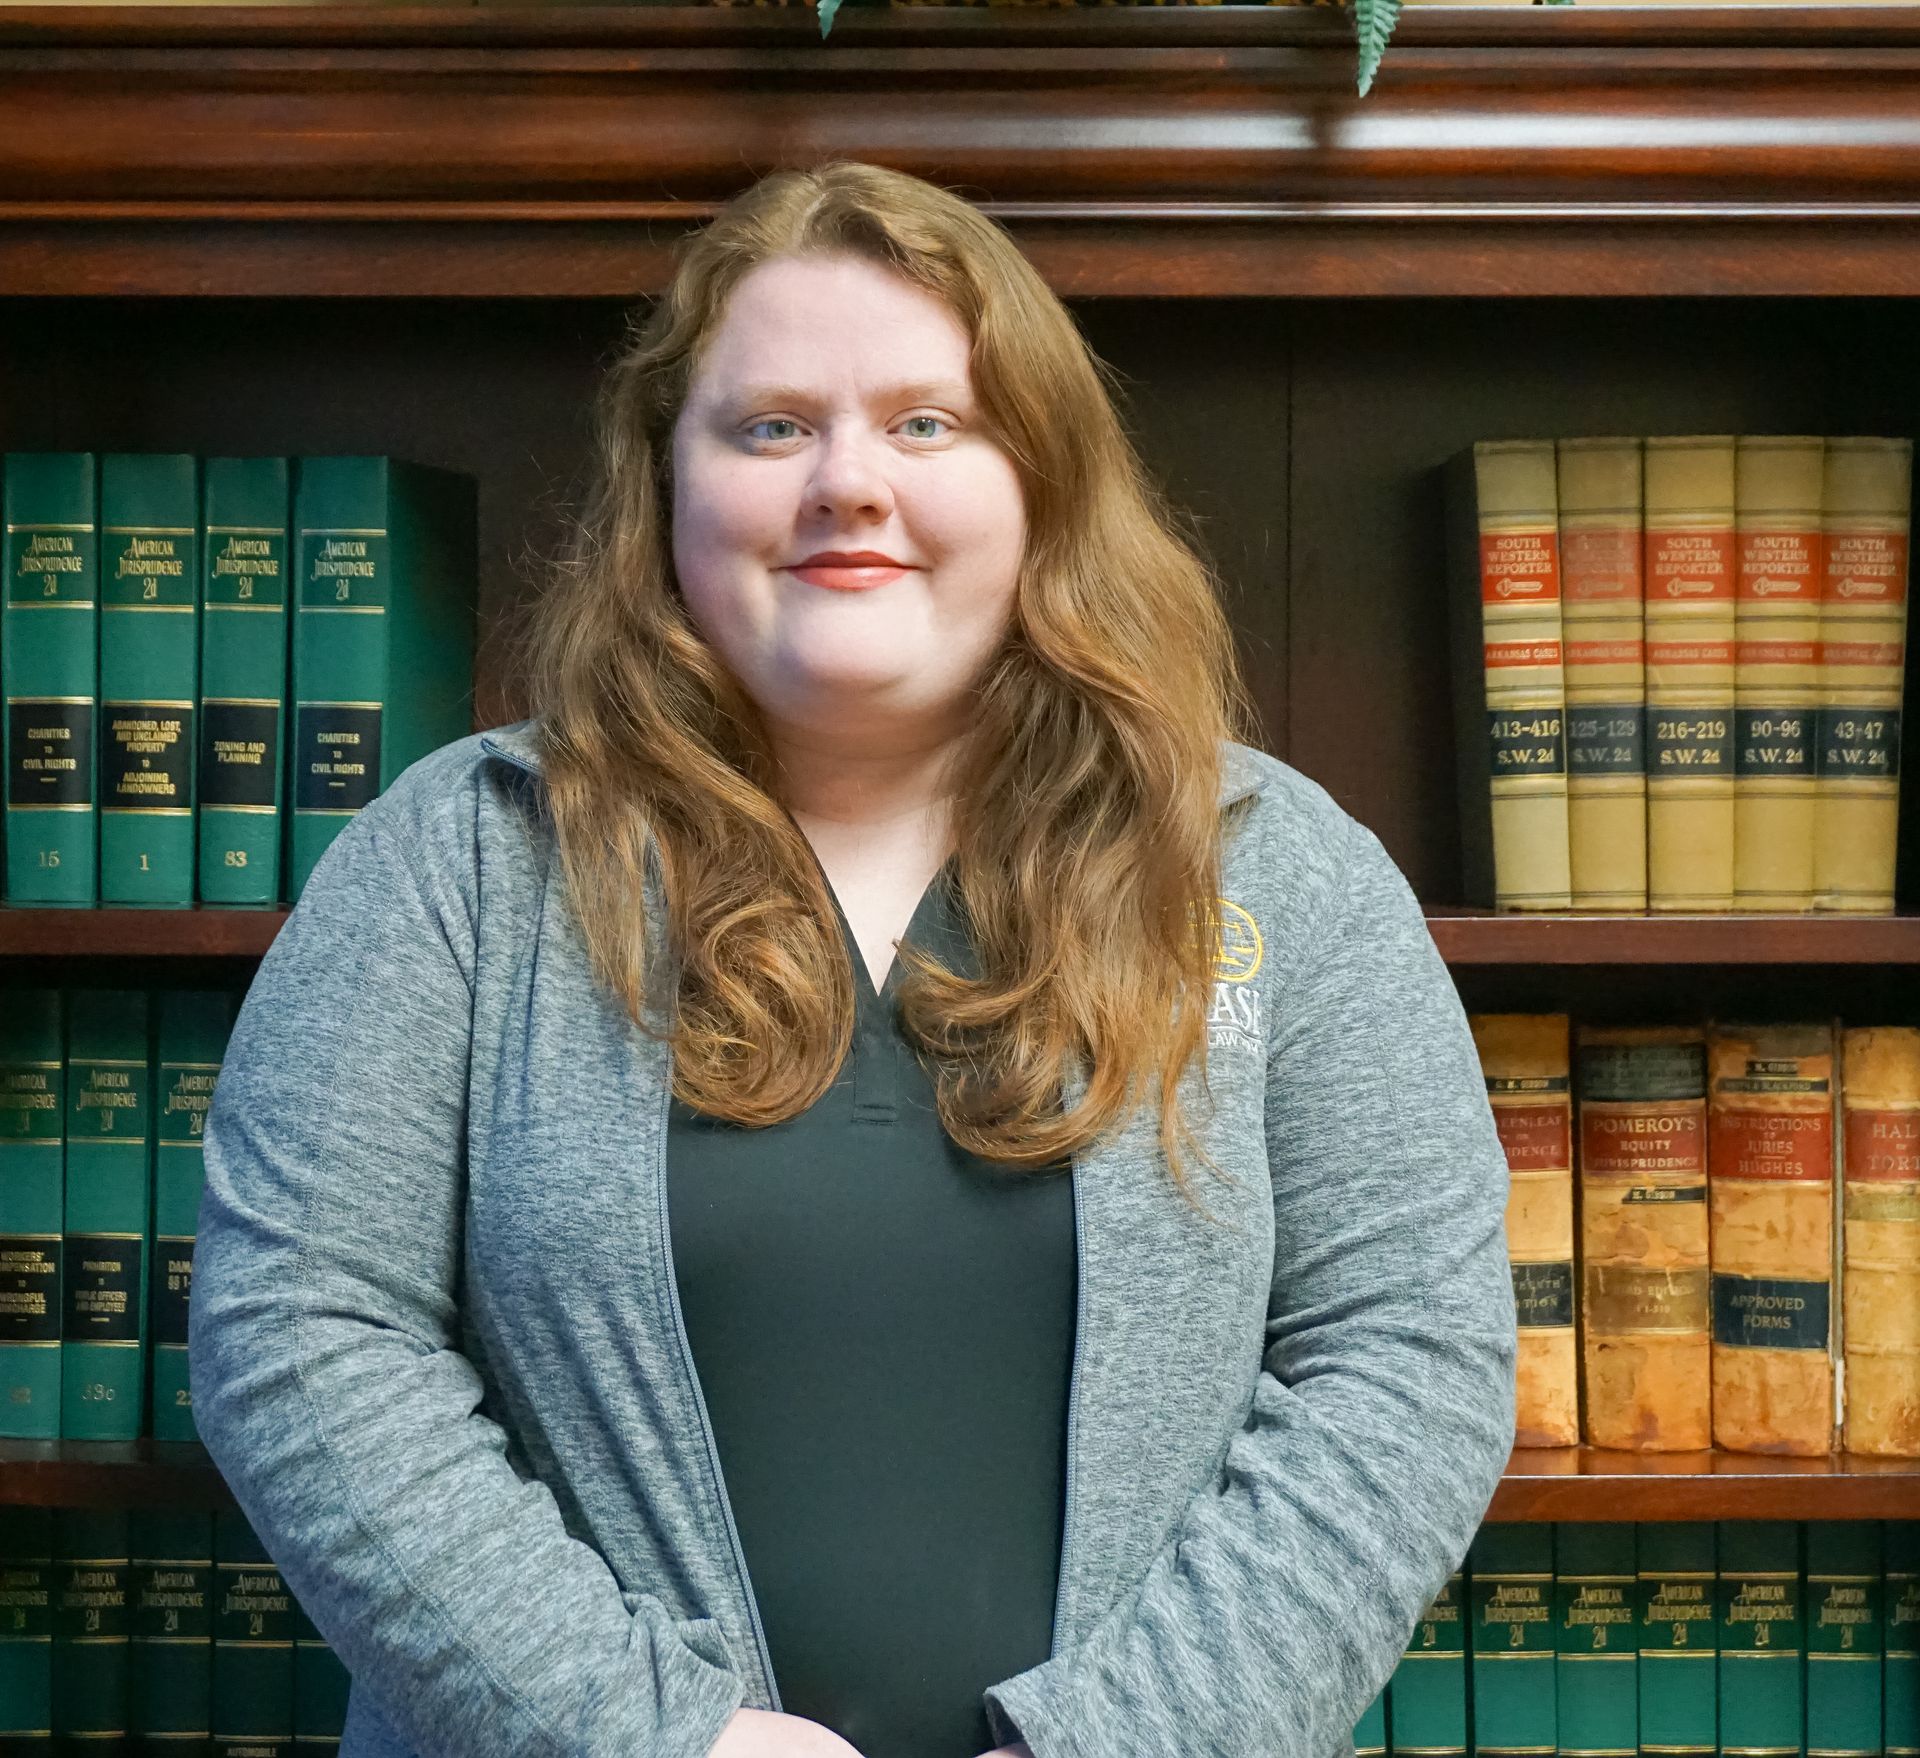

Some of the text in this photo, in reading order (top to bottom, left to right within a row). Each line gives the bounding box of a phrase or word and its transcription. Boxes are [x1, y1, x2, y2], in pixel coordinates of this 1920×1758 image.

[26, 534, 73, 554] AMERICAN
[124, 536, 174, 558] AMERICAN
[221, 536, 270, 558] AMERICAN
[319, 539, 368, 560] AMERICAN
[1496, 538, 1540, 550] SOUTH
[1666, 538, 1712, 549] SOUTH
[1754, 537, 1799, 548] SOUTH
[1839, 539, 1886, 550] SOUTH
[1487, 550, 1549, 561] WESTERN
[1658, 550, 1721, 561] WESTERN
[1744, 550, 1808, 561] WESTERN
[1831, 551, 1894, 562] WESTERN
[114, 557, 183, 579] JURISPRUDENCE
[212, 556, 279, 579] JURISPRUDENCE
[310, 558, 375, 581] JURISPRUDENCE
[1486, 562, 1552, 574] REPORTER
[1655, 562, 1724, 575] REPORTER
[1743, 562, 1809, 574] REPORTER
[1828, 563, 1896, 576] REPORTER
[143, 577, 157, 599] 2d
[112, 720, 182, 732] ABANDONED, LOST,
[1490, 720, 1560, 738] 413-416
[1570, 720, 1636, 737] 125-129
[1657, 721, 1726, 739] 216-219
[1751, 720, 1800, 738] 90-96
[1834, 721, 1884, 739] 43-47
[27, 728, 71, 739] CHARITIES
[133, 731, 178, 743] UNCLAIMED
[317, 733, 361, 745] CHARITIES
[126, 742, 166, 753] PROPERTY
[214, 741, 266, 753] ZONING AND
[218, 752, 261, 764] PLANNING
[1497, 748, 1554, 764] S.W. 2d
[1573, 748, 1632, 762] S.W. 2d
[1660, 749, 1720, 764] S.W. 2d
[1745, 749, 1804, 763] S.W. 2d
[1826, 749, 1886, 764] S.W. 2d
[22, 758, 77, 770] CIVIL RIGHTS
[311, 763, 365, 775] CIVIL RIGHTS
[123, 772, 169, 783] ADJOINING
[117, 783, 176, 795] LANDOWNERS
[39, 851, 61, 868] 15
[139, 854, 150, 871] 1
[224, 851, 247, 868] 83
[88, 1069, 129, 1089] AMERICAN
[1594, 1116, 1697, 1132] POMEROY'S
[1720, 1116, 1821, 1131] INSTRUCTIONS
[1621, 1140, 1671, 1152] EQUITY
[1748, 1140, 1793, 1154] JURIES
[1738, 1159, 1804, 1175] HUGHES
[1731, 1295, 1805, 1311] APPROVED
[1744, 1315, 1791, 1329] FORMS
[231, 1573, 280, 1596] AMERICAN
